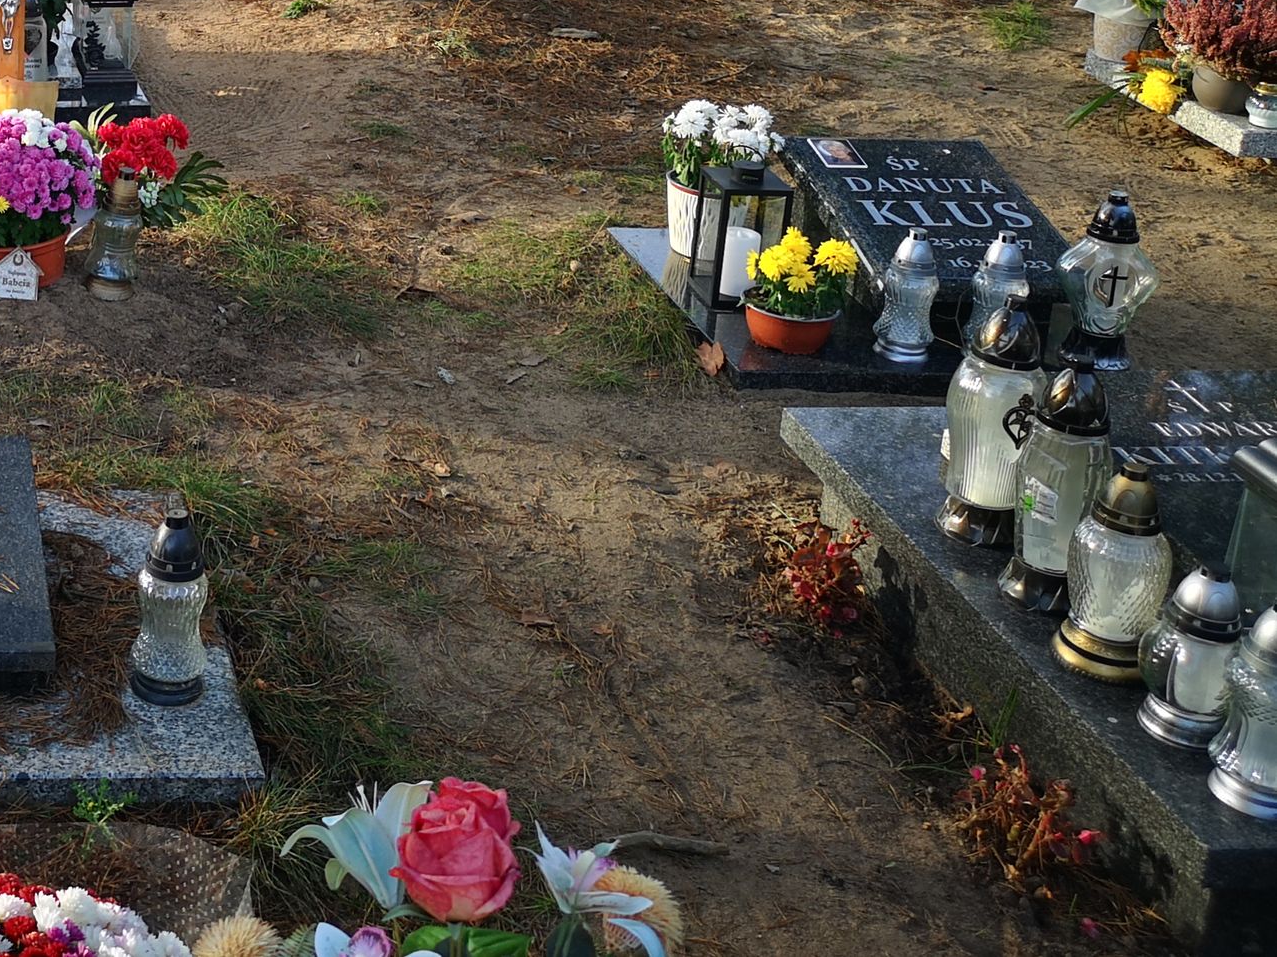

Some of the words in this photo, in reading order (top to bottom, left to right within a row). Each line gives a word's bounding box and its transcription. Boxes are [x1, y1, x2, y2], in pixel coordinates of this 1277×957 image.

[886, 155, 929, 171] ŚP.
[842, 177, 1006, 195] DANUTA
[856, 200, 1034, 229] KLUS
[2, 278, 30, 287] Babcia
[1150, 422, 1277, 437] EDWAR
